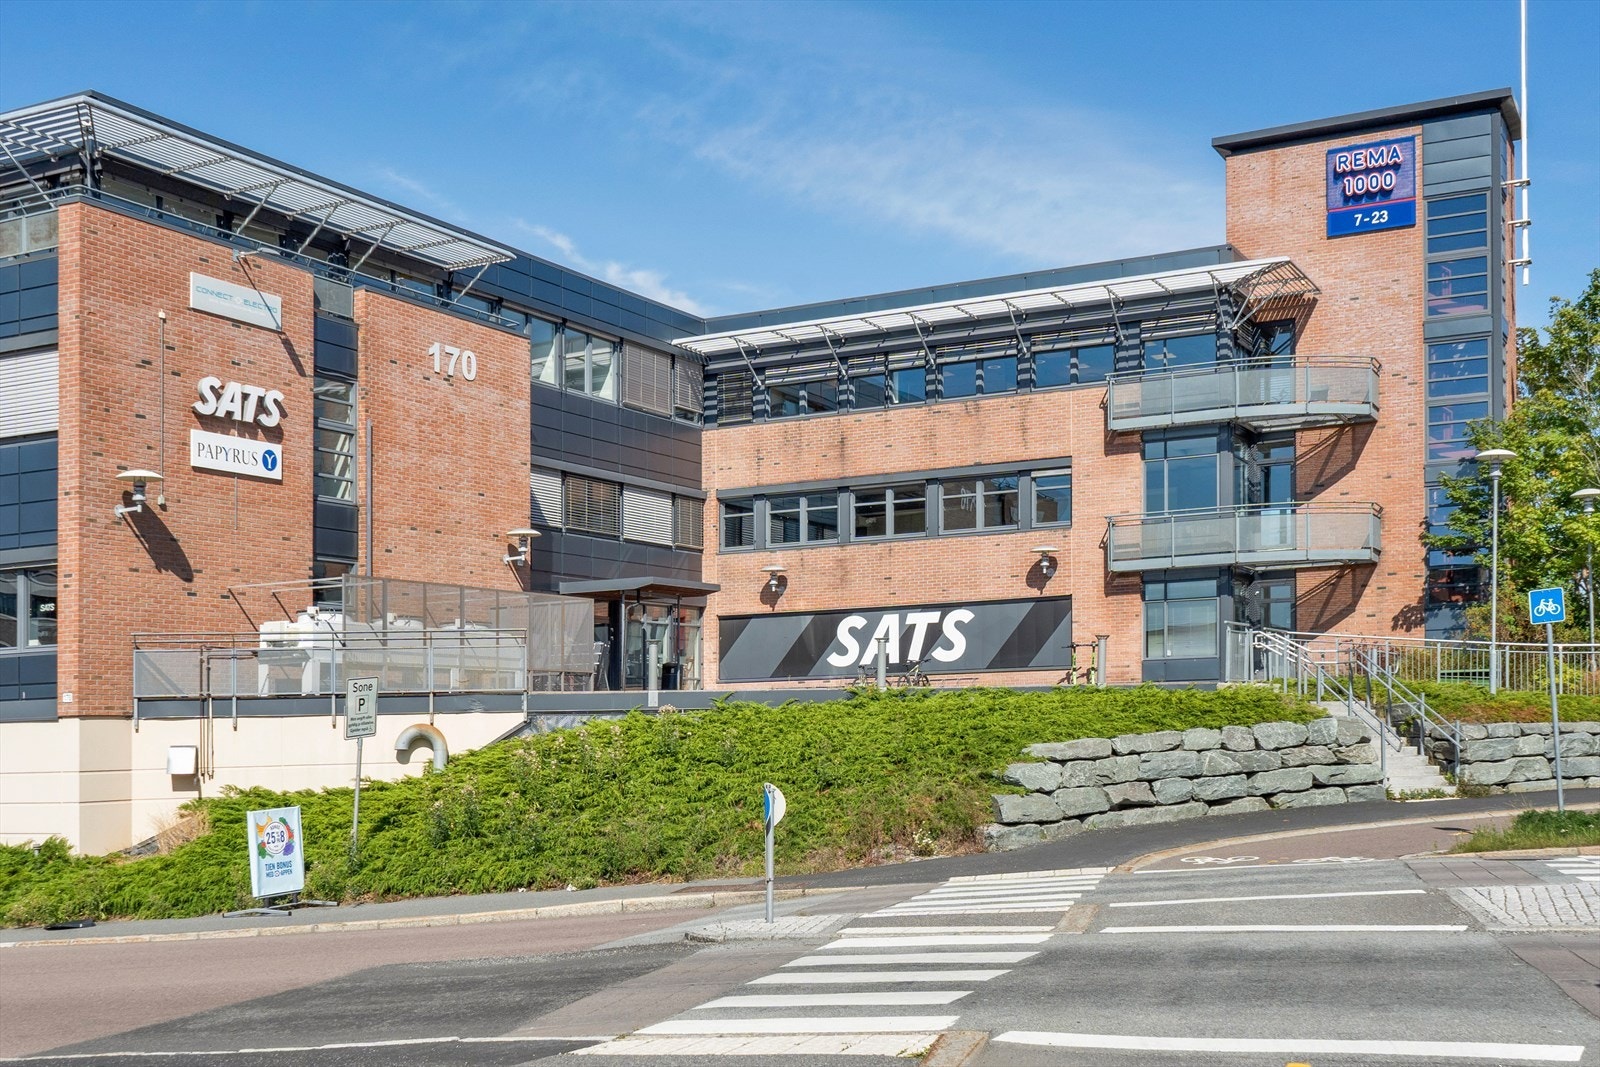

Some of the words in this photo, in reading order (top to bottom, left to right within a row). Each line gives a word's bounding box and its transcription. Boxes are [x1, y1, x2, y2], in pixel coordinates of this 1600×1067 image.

[1336, 145, 1402, 171] REMA
[1344, 171, 1396, 196] 1000
[1354, 210, 1388, 226] 7-23
[196, 286, 233, 301] CONNECT
[428, 342, 477, 381] 170
[191, 376, 285, 427] SATS
[197, 443, 259, 466] PAPYRUS
[827, 609, 975, 667] SATS
[352, 682, 373, 693] Sone
[358, 698, 366, 712] P
[266, 832, 276, 844] 25
